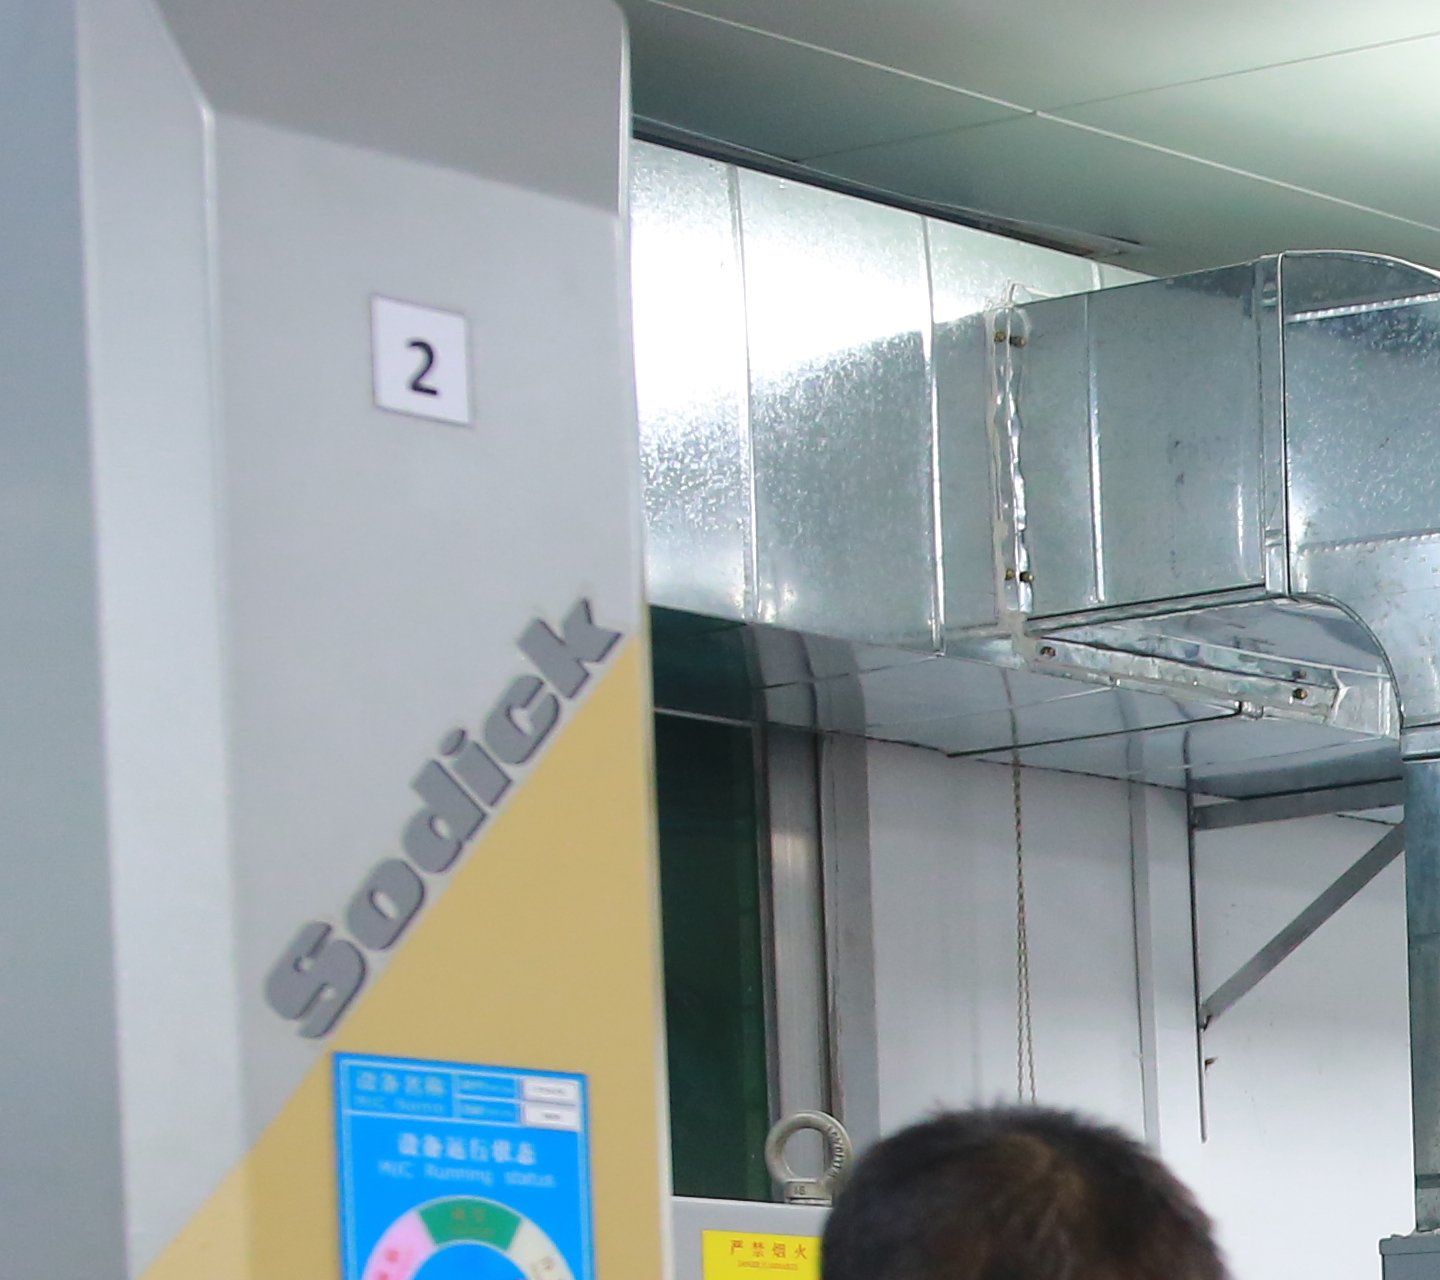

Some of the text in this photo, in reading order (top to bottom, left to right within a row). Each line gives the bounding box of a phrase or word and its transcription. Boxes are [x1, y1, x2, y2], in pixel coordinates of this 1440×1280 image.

[406, 340, 439, 396] 2
[265, 597, 623, 1041] Sodick
[730, 1239, 808, 1260] 严禁烟火
